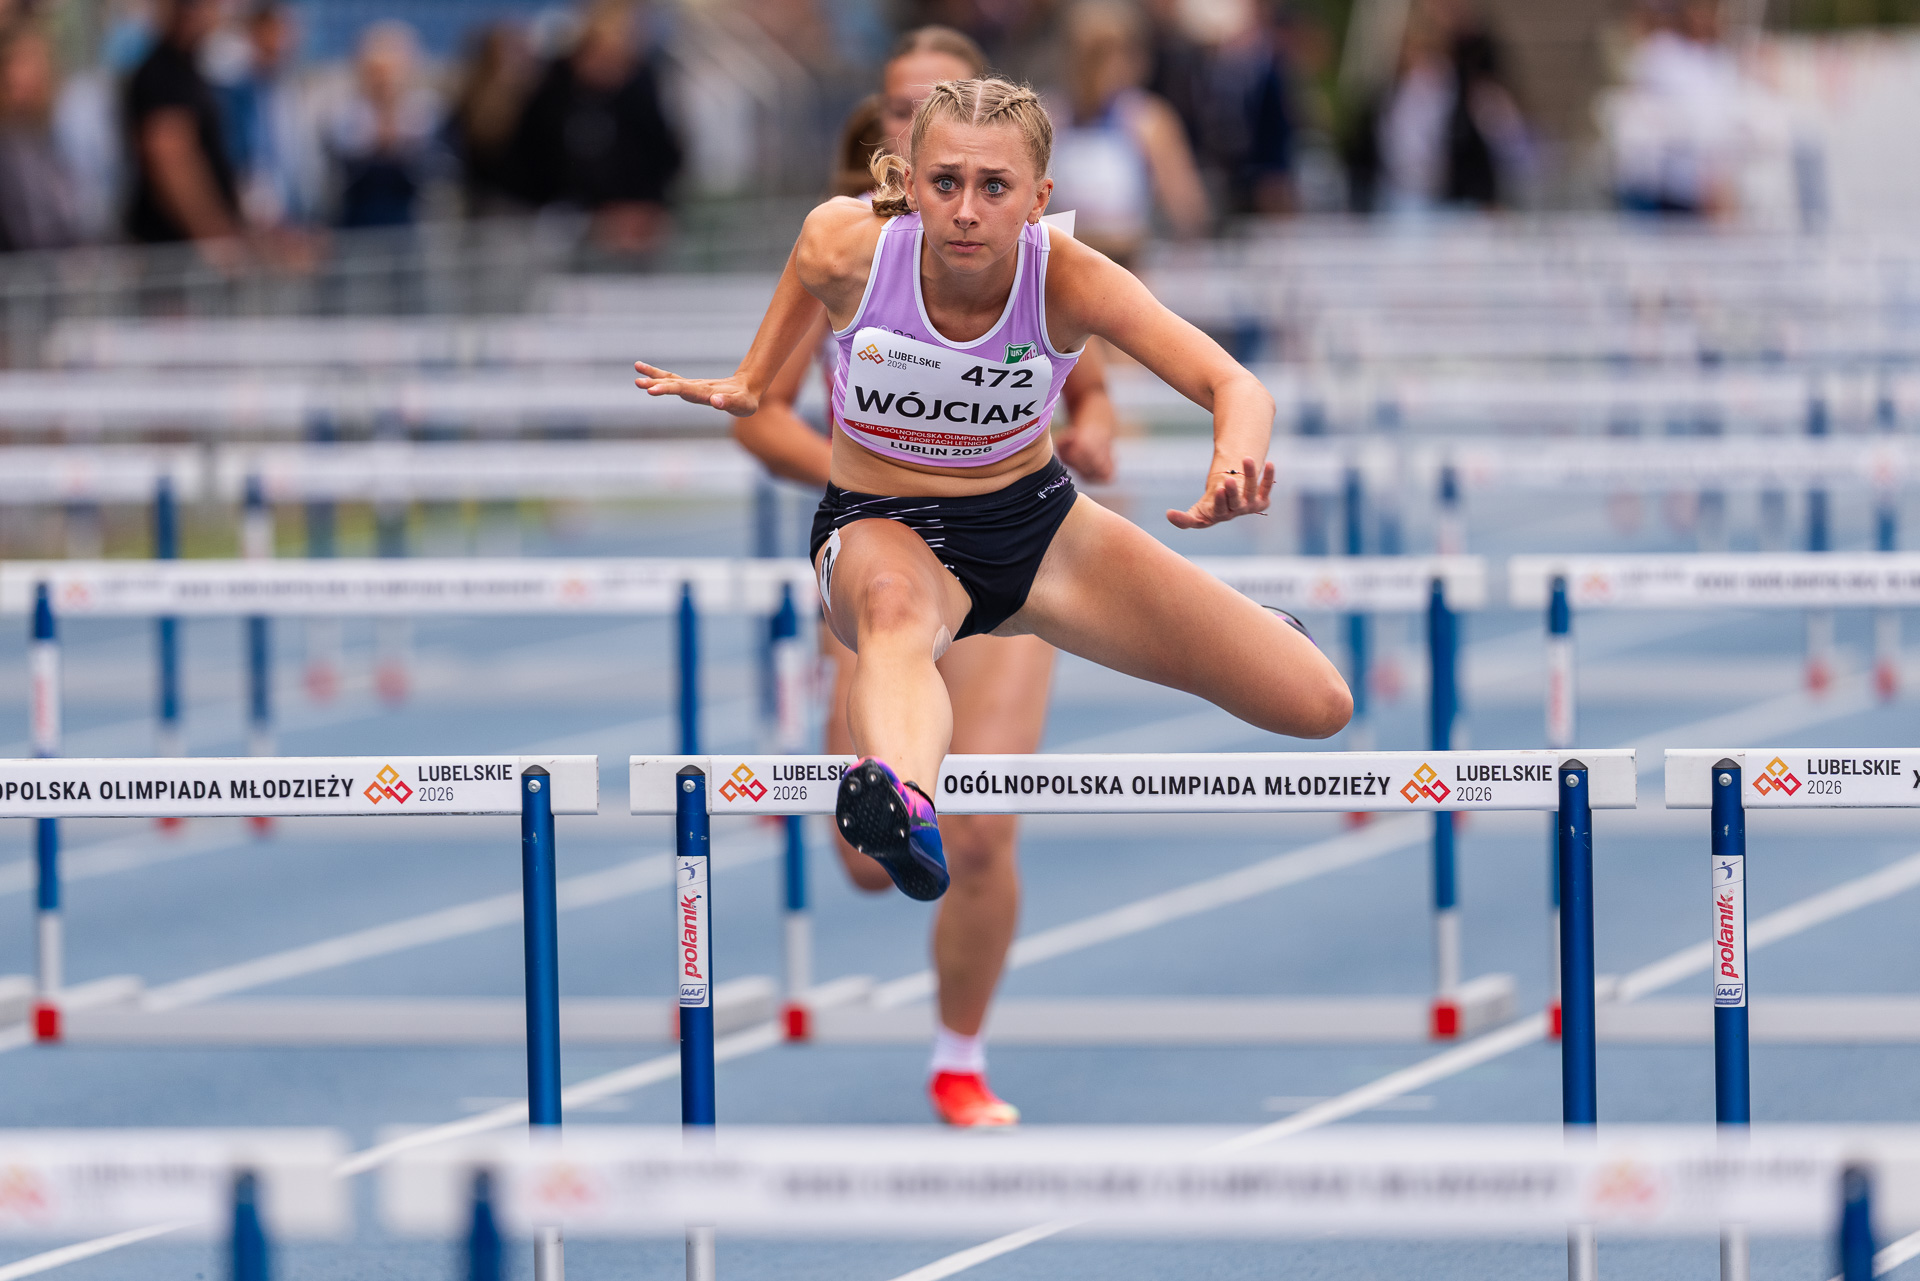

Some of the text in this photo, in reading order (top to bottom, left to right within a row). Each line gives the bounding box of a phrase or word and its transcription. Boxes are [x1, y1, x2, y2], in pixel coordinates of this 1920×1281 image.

[887, 359, 907, 370] 2026
[888, 349, 941, 369] LUBELSKIE
[961, 366, 1033, 388] 472
[855, 385, 1038, 424] WÓJCIAK
[855, 421, 875, 431] XXXII
[876, 426, 943, 439] OGÓLNOPOLSKA
[944, 433, 988, 441] OLIMPIADA
[890, 441, 992, 456] LUBLIN 2026
[908, 436, 953, 446] SPORTACH
[418, 764, 513, 782] LUBELSKIE
[1456, 764, 1553, 782] LUBELSKIE
[1807, 758, 1901, 776] LUBELSKIE
[0, 774, 354, 800] POLSKA OLIMPIADA MŁODZIEŻY
[944, 770, 1391, 796] OGÓLNOPOLSKA OLIMPIADA MŁODZIEŻY
[1807, 780, 1842, 795] 2026
[419, 786, 454, 802] 2026
[773, 786, 808, 801] 2026
[1456, 786, 1492, 802] 2026
[680, 894, 703, 979] polanik
[1716, 893, 1740, 979] polanik
[681, 988, 704, 996] IAAF
[1717, 988, 1741, 996] IAAF
